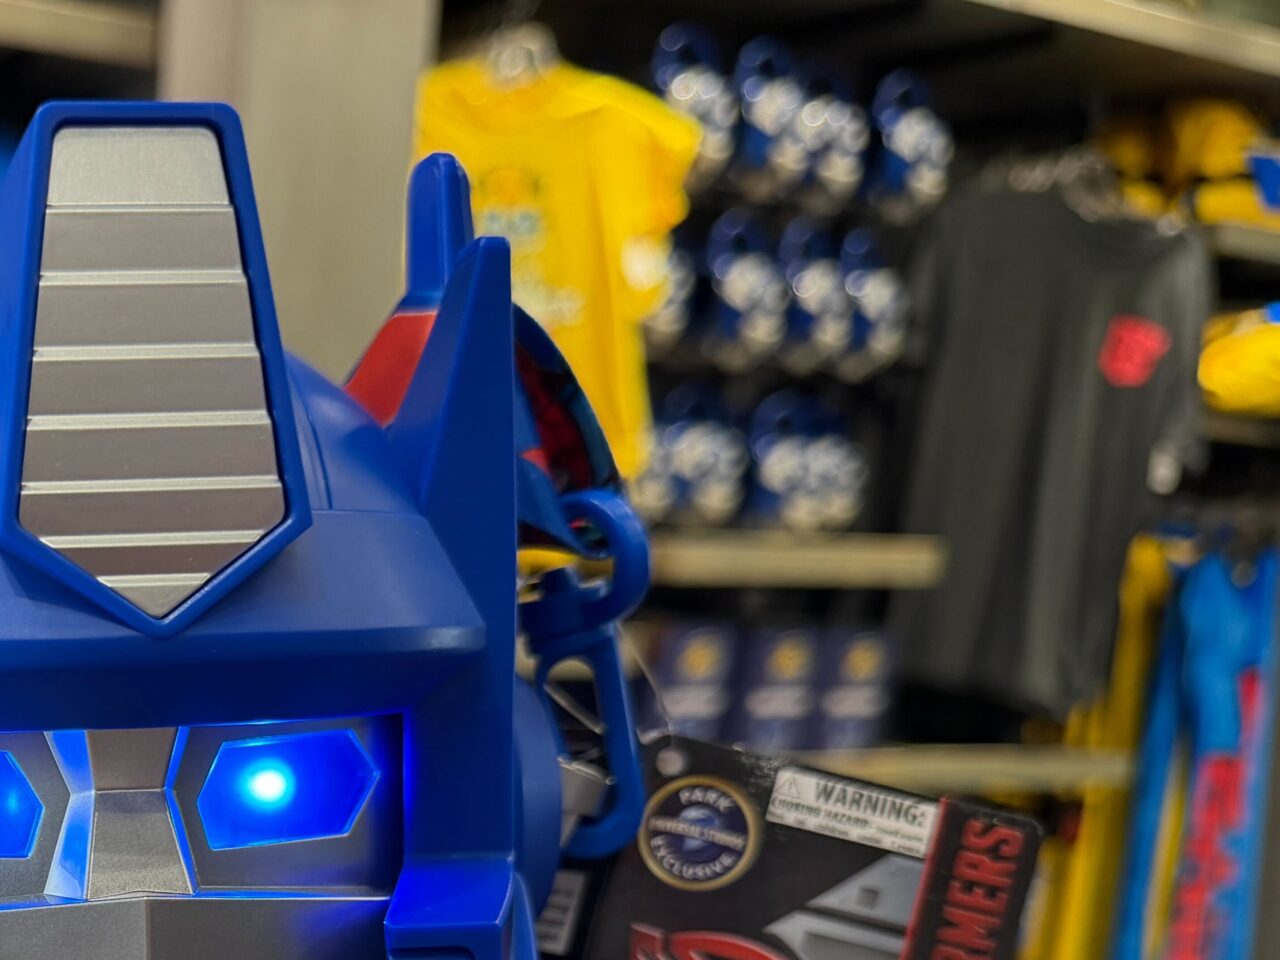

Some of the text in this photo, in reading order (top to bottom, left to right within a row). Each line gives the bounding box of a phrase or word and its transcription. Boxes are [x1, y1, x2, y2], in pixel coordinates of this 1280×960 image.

[678, 786, 737, 813] PARK
[771, 796, 820, 818] CHOKING
[815, 780, 925, 827] WARNING:
[648, 817, 702, 841] UNIVERSAL
[650, 835, 737, 879] EXCLUSIVE
